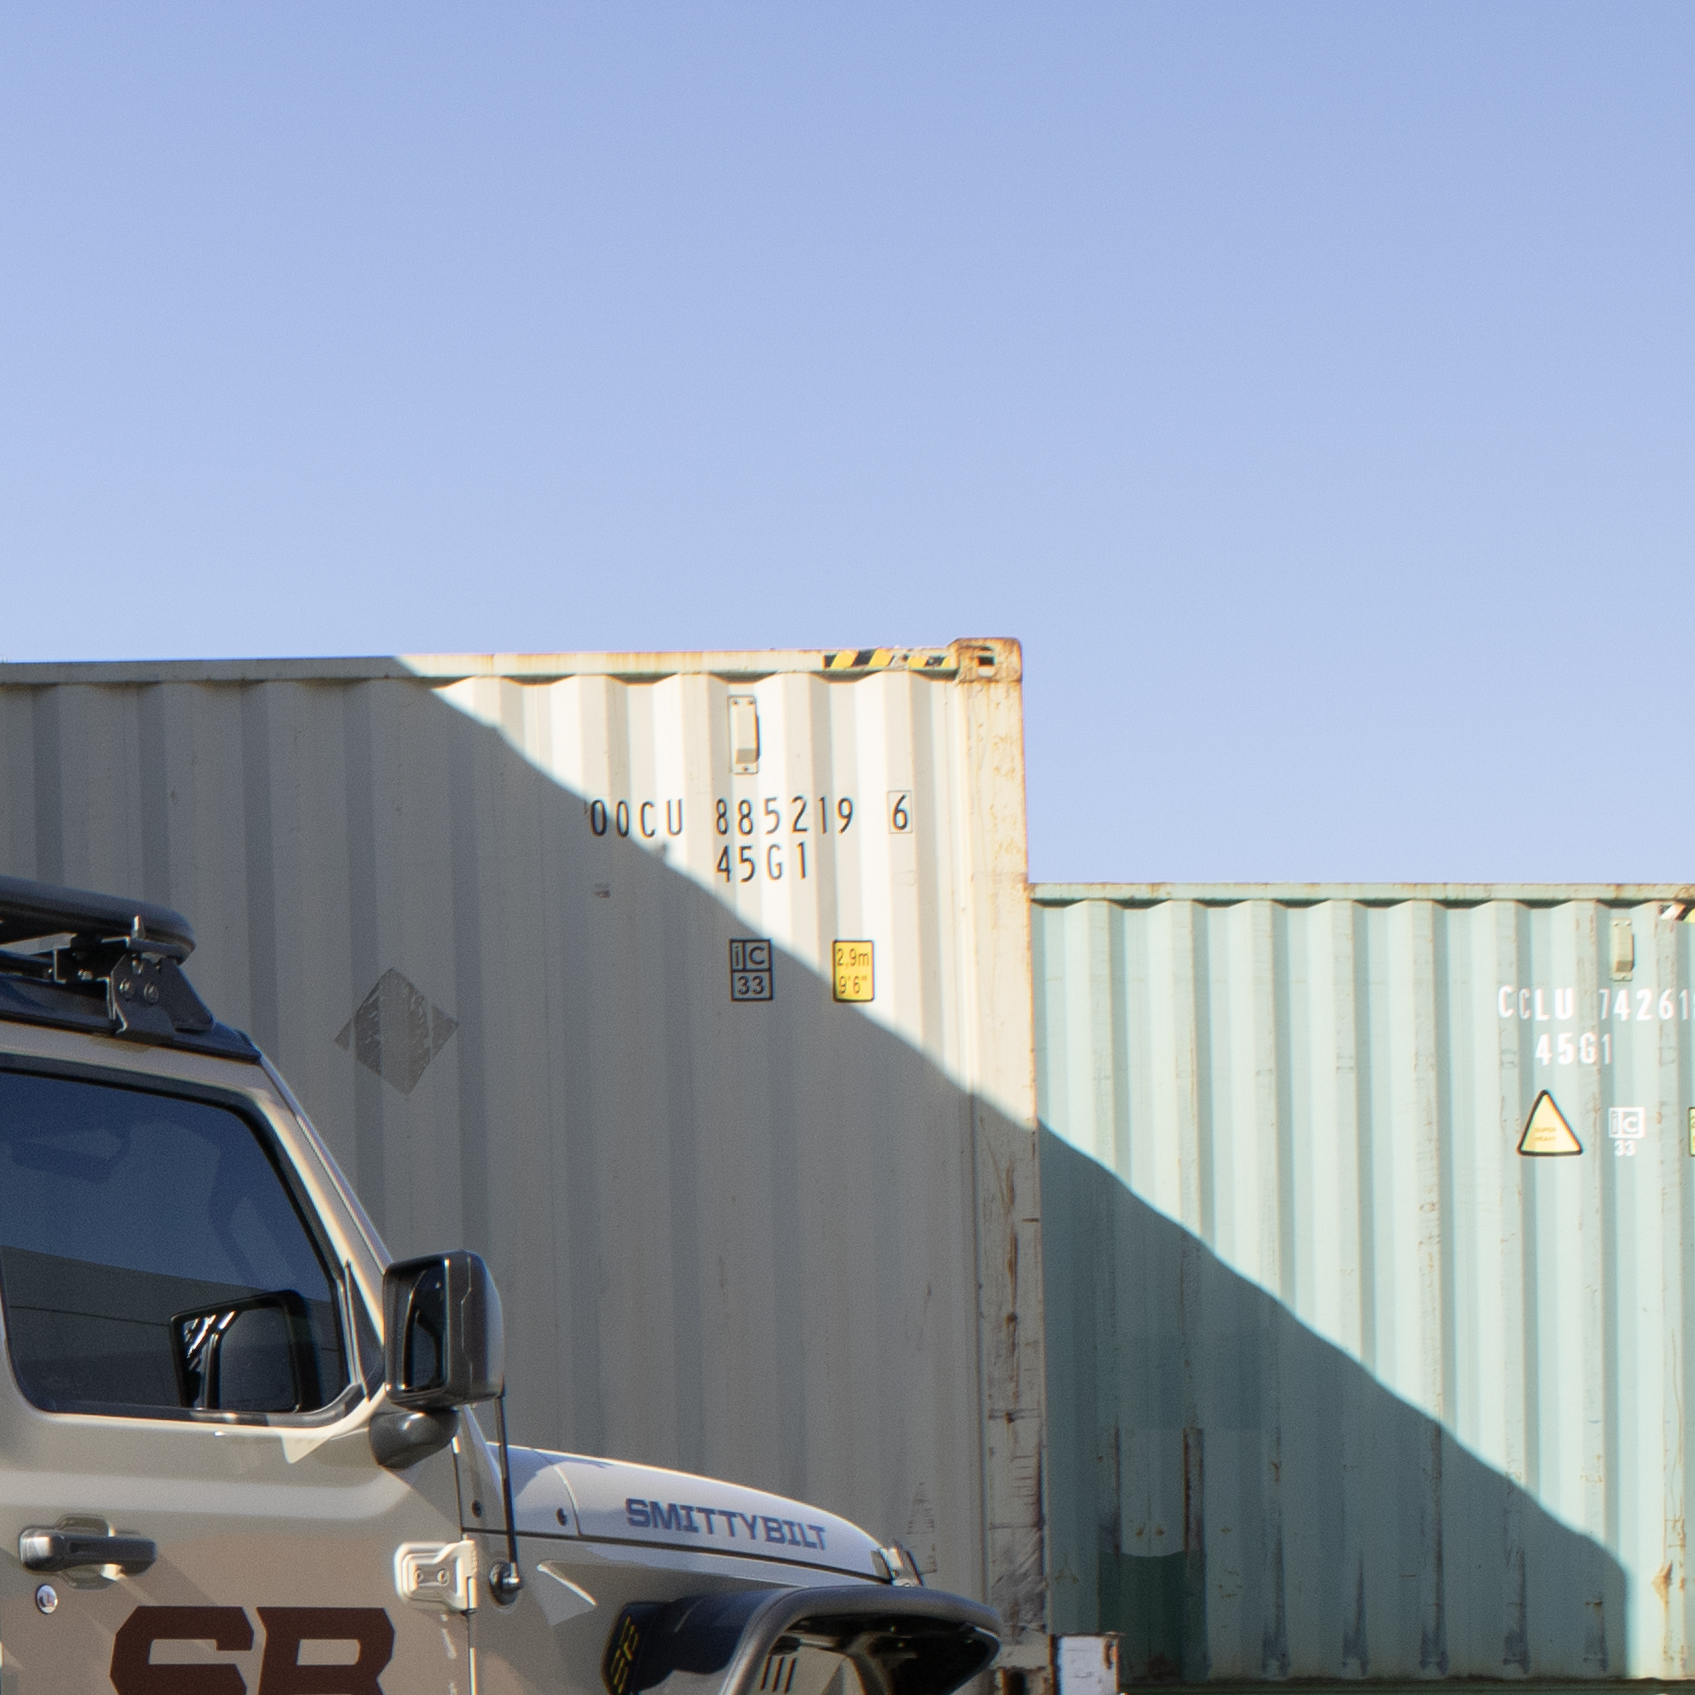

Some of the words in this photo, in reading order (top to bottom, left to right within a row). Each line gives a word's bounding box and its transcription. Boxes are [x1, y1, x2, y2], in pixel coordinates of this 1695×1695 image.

[714, 795, 854, 837] 885219
[891, 793, 909, 832] 6
[715, 840, 807, 883] 45G1
[737, 975, 764, 995] 33
[1497, 985, 1574, 1020] CCLU
[1598, 987, 1695, 1021] 74261
[1534, 1031, 1612, 1066] 45G1
[1614, 1139, 1636, 1157] 33
[625, 1497, 826, 1551] SMITTYBILT
